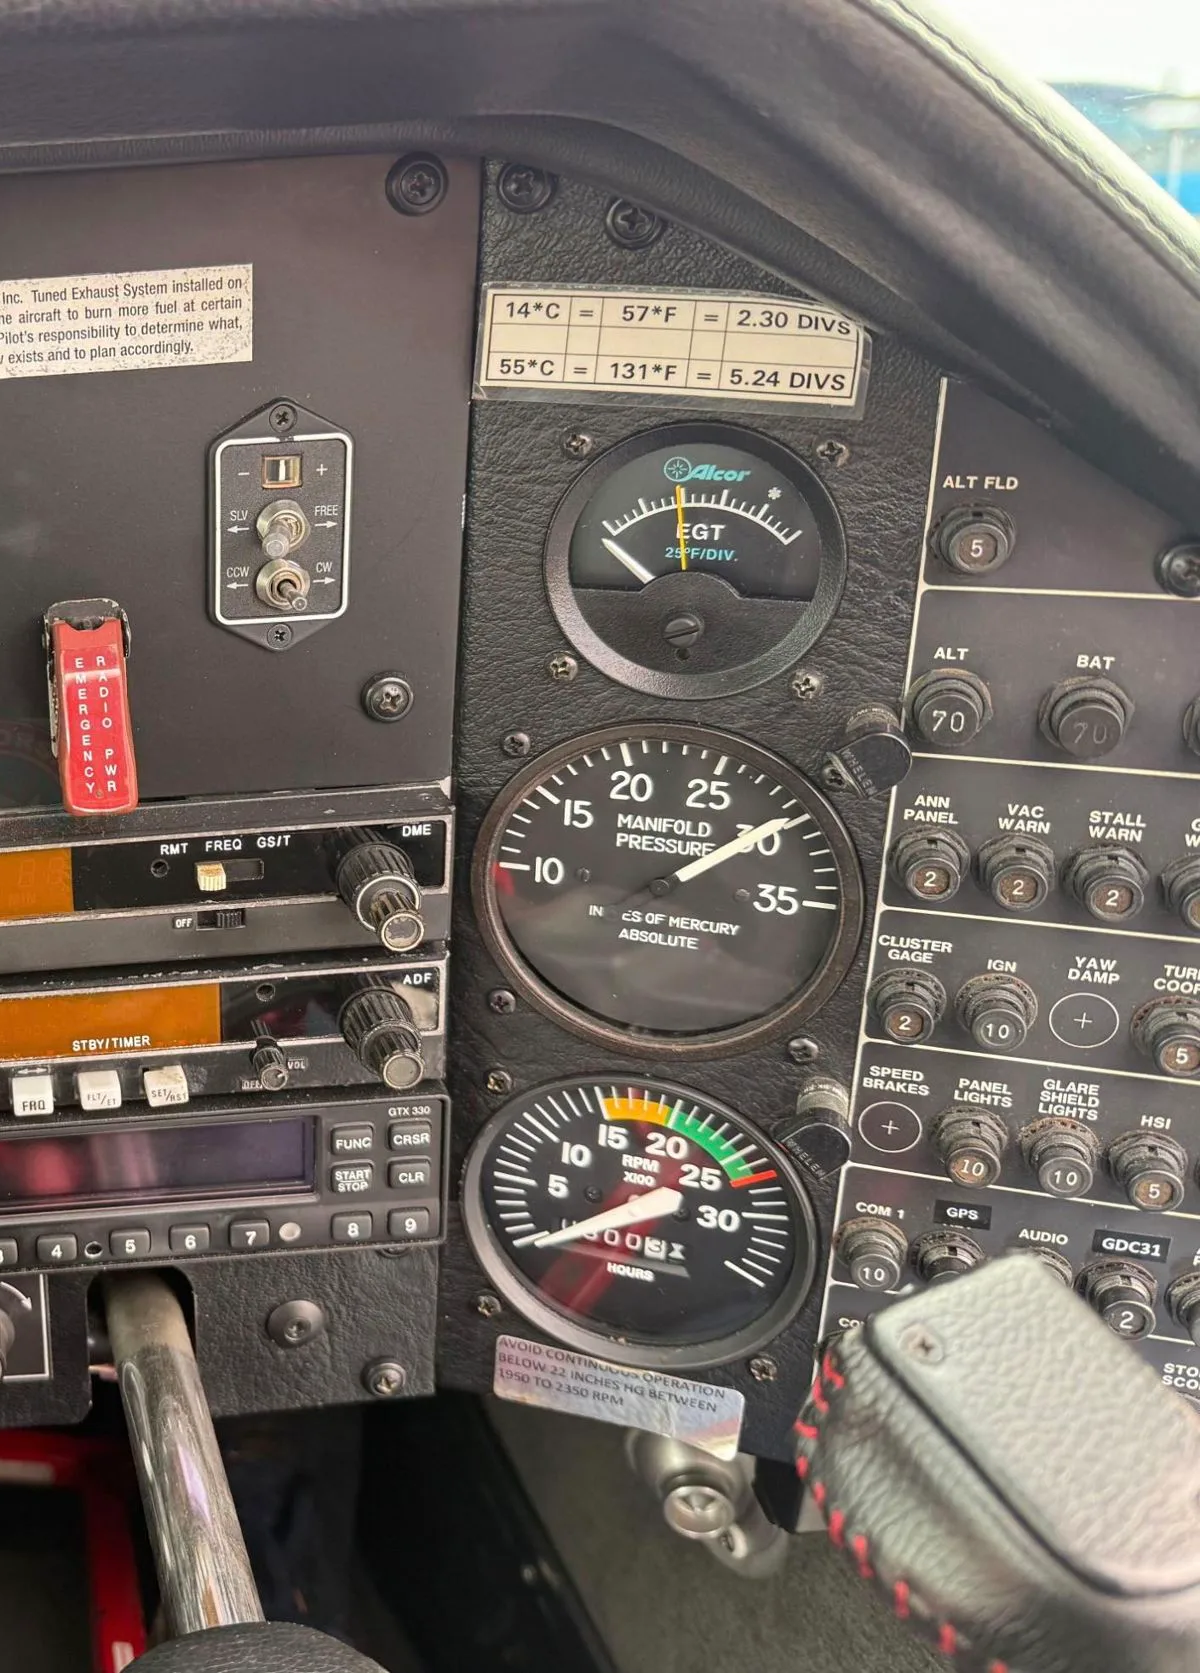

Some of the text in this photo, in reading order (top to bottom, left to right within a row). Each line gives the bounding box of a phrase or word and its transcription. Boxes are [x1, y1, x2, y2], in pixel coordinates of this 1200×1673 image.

[2, 292, 23, 305] Inc.
[31, 288, 67, 303] Tuned
[72, 285, 119, 301] Exhaust
[123, 282, 167, 299] System
[172, 277, 223, 294] installed
[227, 278, 242, 290] on
[19, 308, 61, 324] aircraft
[67, 307, 79, 320] to
[84, 305, 112, 320] burn
[118, 304, 149, 317] more
[155, 301, 177, 315] fuel
[183, 301, 195, 313] at
[201, 297, 242, 311] certain
[729, 368, 780, 388] 5.24
[789, 373, 845, 391] DIVS
[943, 476, 1019, 490] ALT FLD
[314, 504, 339, 517] FREE
[226, 566, 250, 578] CCW
[316, 561, 333, 573] CW
[934, 647, 969, 661] ALT
[1076, 655, 1116, 670] BAT
[610, 771, 653, 802] 20
[686, 779, 731, 810] 25
[564, 799, 594, 829] 15
[903, 809, 959, 825] PANEL
[1089, 810, 1147, 828] STALL
[402, 825, 432, 837] DME
[617, 813, 712, 838] MANIFOLD
[999, 817, 1051, 835] WARN
[1088, 825, 1143, 843] WARN
[161, 835, 291, 855] RMT FREQ GS/T
[535, 856, 564, 885] 10
[753, 884, 799, 915] 35
[618, 928, 700, 950] ABSOLUTE
[878, 935, 953, 953] CLUSTER
[403, 973, 432, 985] ADF
[1067, 967, 1120, 985] DAMP
[72, 1035, 150, 1052] STBY/TIMER
[869, 1066, 925, 1082] SPEED
[862, 1077, 930, 1097] BRAKES
[958, 1078, 1012, 1096] PANEL
[1043, 1079, 1100, 1096] GLARE
[22, 1099, 46, 1112] FRQ
[953, 1090, 1013, 1108] LIGHTS
[1039, 1090, 1100, 1108] SHIELD
[1038, 1103, 1098, 1121] LIGHTS
[1141, 1115, 1172, 1130] HSI
[336, 1137, 372, 1150] FUNC
[393, 1133, 430, 1146] CRSR
[598, 1124, 630, 1150] 15
[645, 1131, 689, 1160] 20
[561, 1142, 592, 1168] 10
[622, 1154, 659, 1173] RPM
[335, 1169, 370, 1181] START
[398, 1172, 425, 1183] CLR
[679, 1163, 723, 1191] 25
[338, 1181, 368, 1192] STOP
[548, 1174, 568, 1198] 5
[697, 1205, 741, 1233] 30
[946, 1207, 979, 1221] GPS
[1019, 1229, 1069, 1246] AUDIO
[1101, 1238, 1161, 1256] GDC31
[606, 1262, 655, 1282] HOURS
[862, 1268, 885, 1281] 10
[499, 1352, 718, 1413] BELOW 22 INCHES HG BETWEEN
